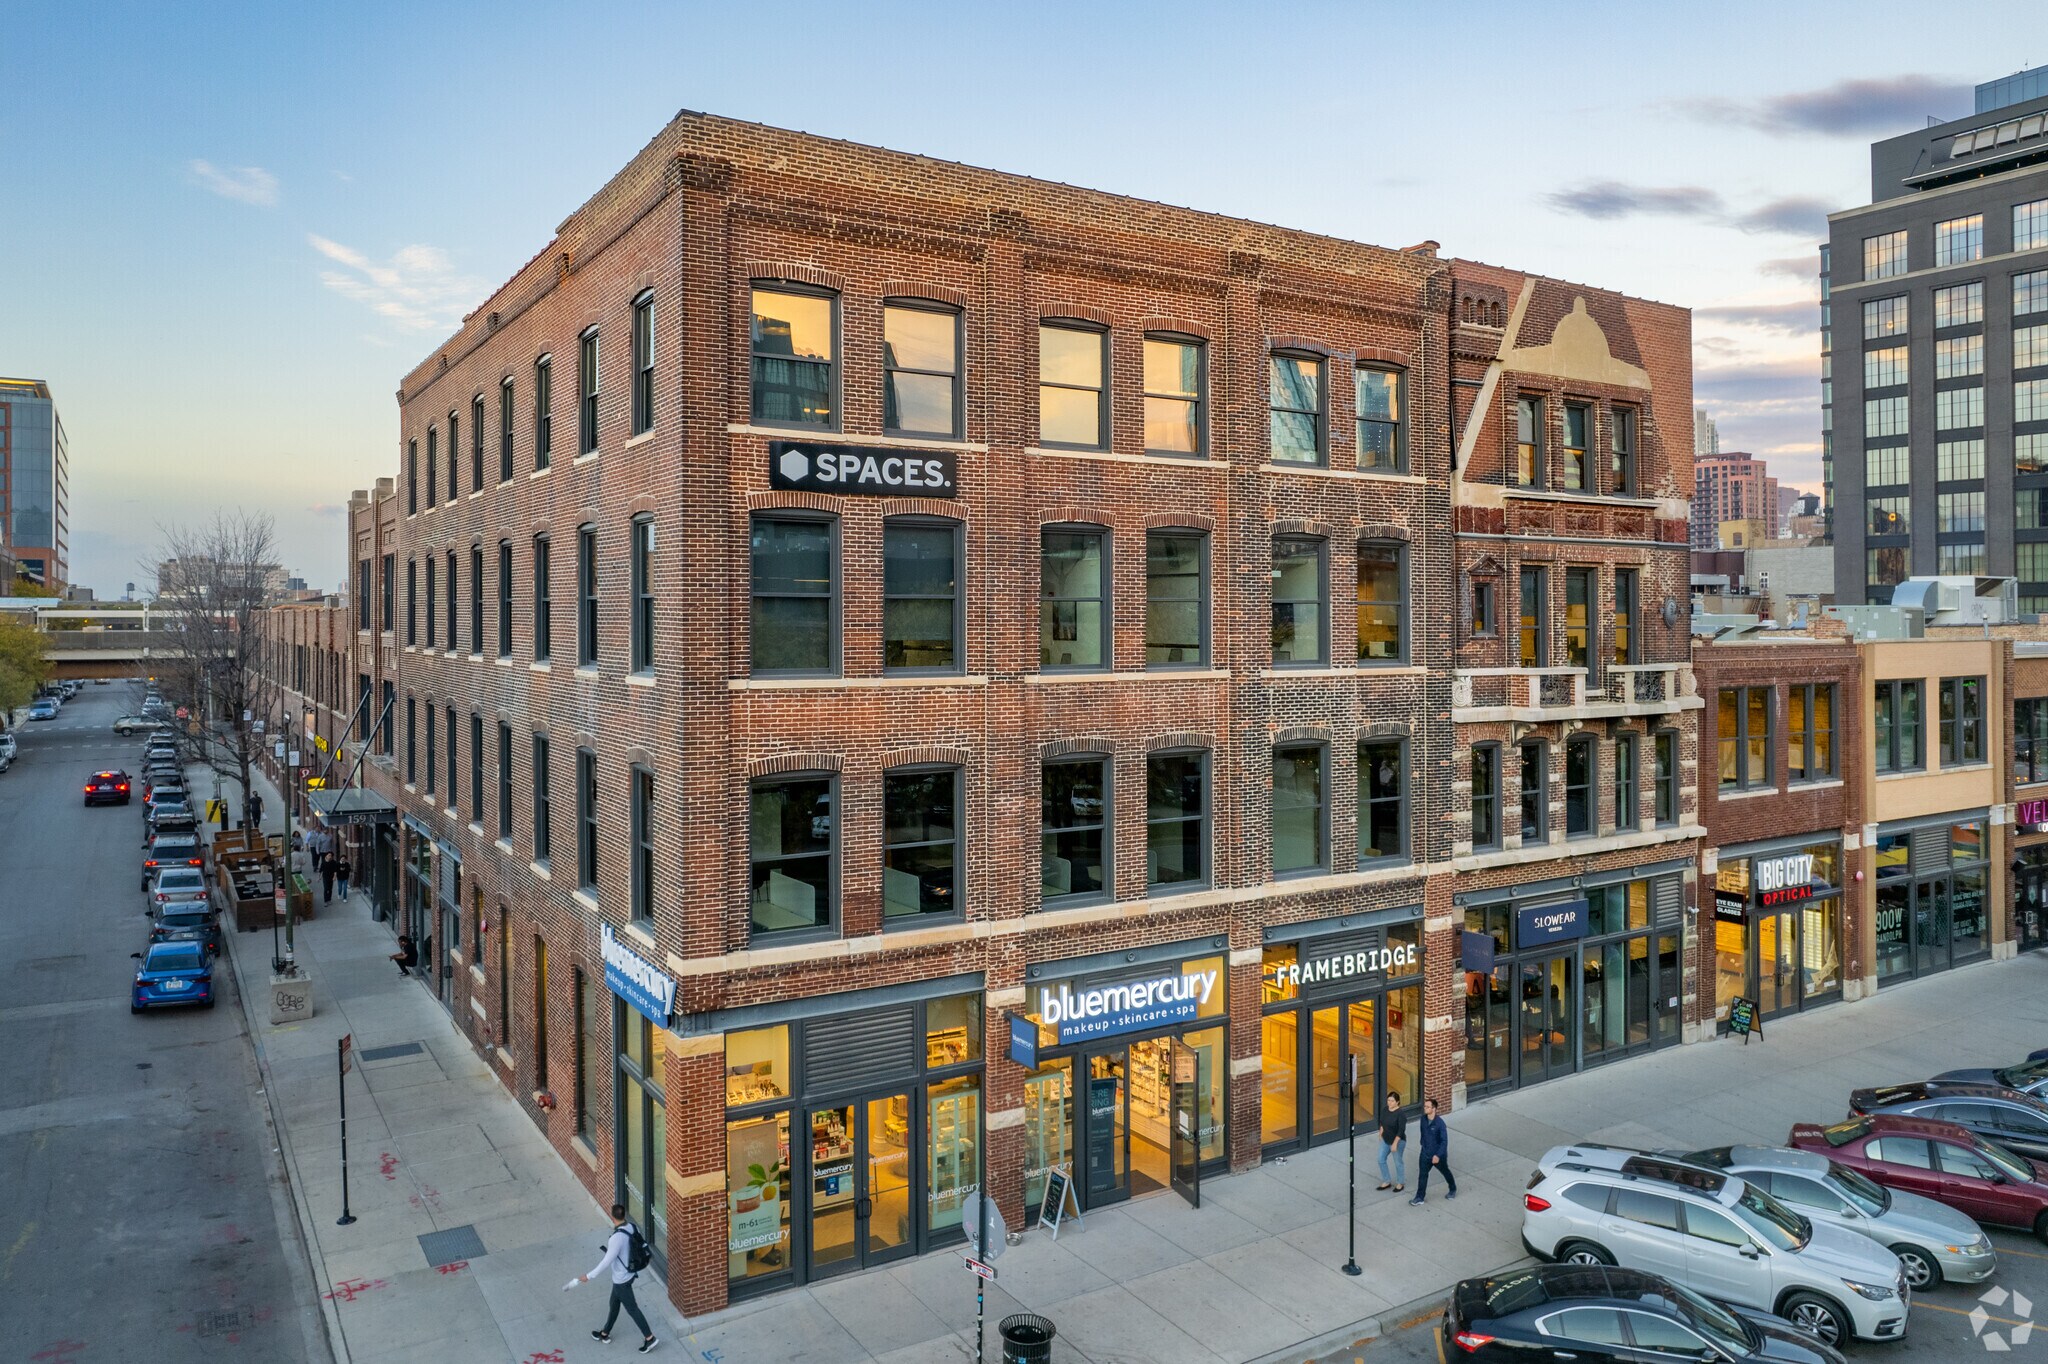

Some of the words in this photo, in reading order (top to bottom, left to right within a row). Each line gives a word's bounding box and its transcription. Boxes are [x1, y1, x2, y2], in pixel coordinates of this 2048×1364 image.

[816, 453, 951, 488] SPACES.
[348, 814, 366, 824] 159
[369, 814, 377, 823] N
[1760, 860, 1784, 890] BIG
[1786, 854, 1813, 887] CITY
[1763, 885, 1813, 905] OPTICAL
[1534, 911, 1576, 928] SLOWEAR
[1277, 943, 1416, 989] FRAMEBRIDGE
[1041, 970, 1217, 1024] bluemercury
[1063, 1019, 1109, 1037] makeup
[1118, 1009, 1167, 1026] skincare
[1176, 1004, 1195, 1017] spa
[869, 1151, 908, 1165] bluemercury
[814, 1162, 854, 1177] bluemercury
[1025, 1160, 1073, 1179] bluemcury
[928, 1182, 981, 1202] bluemercury
[729, 1227, 791, 1251] bluemercury
